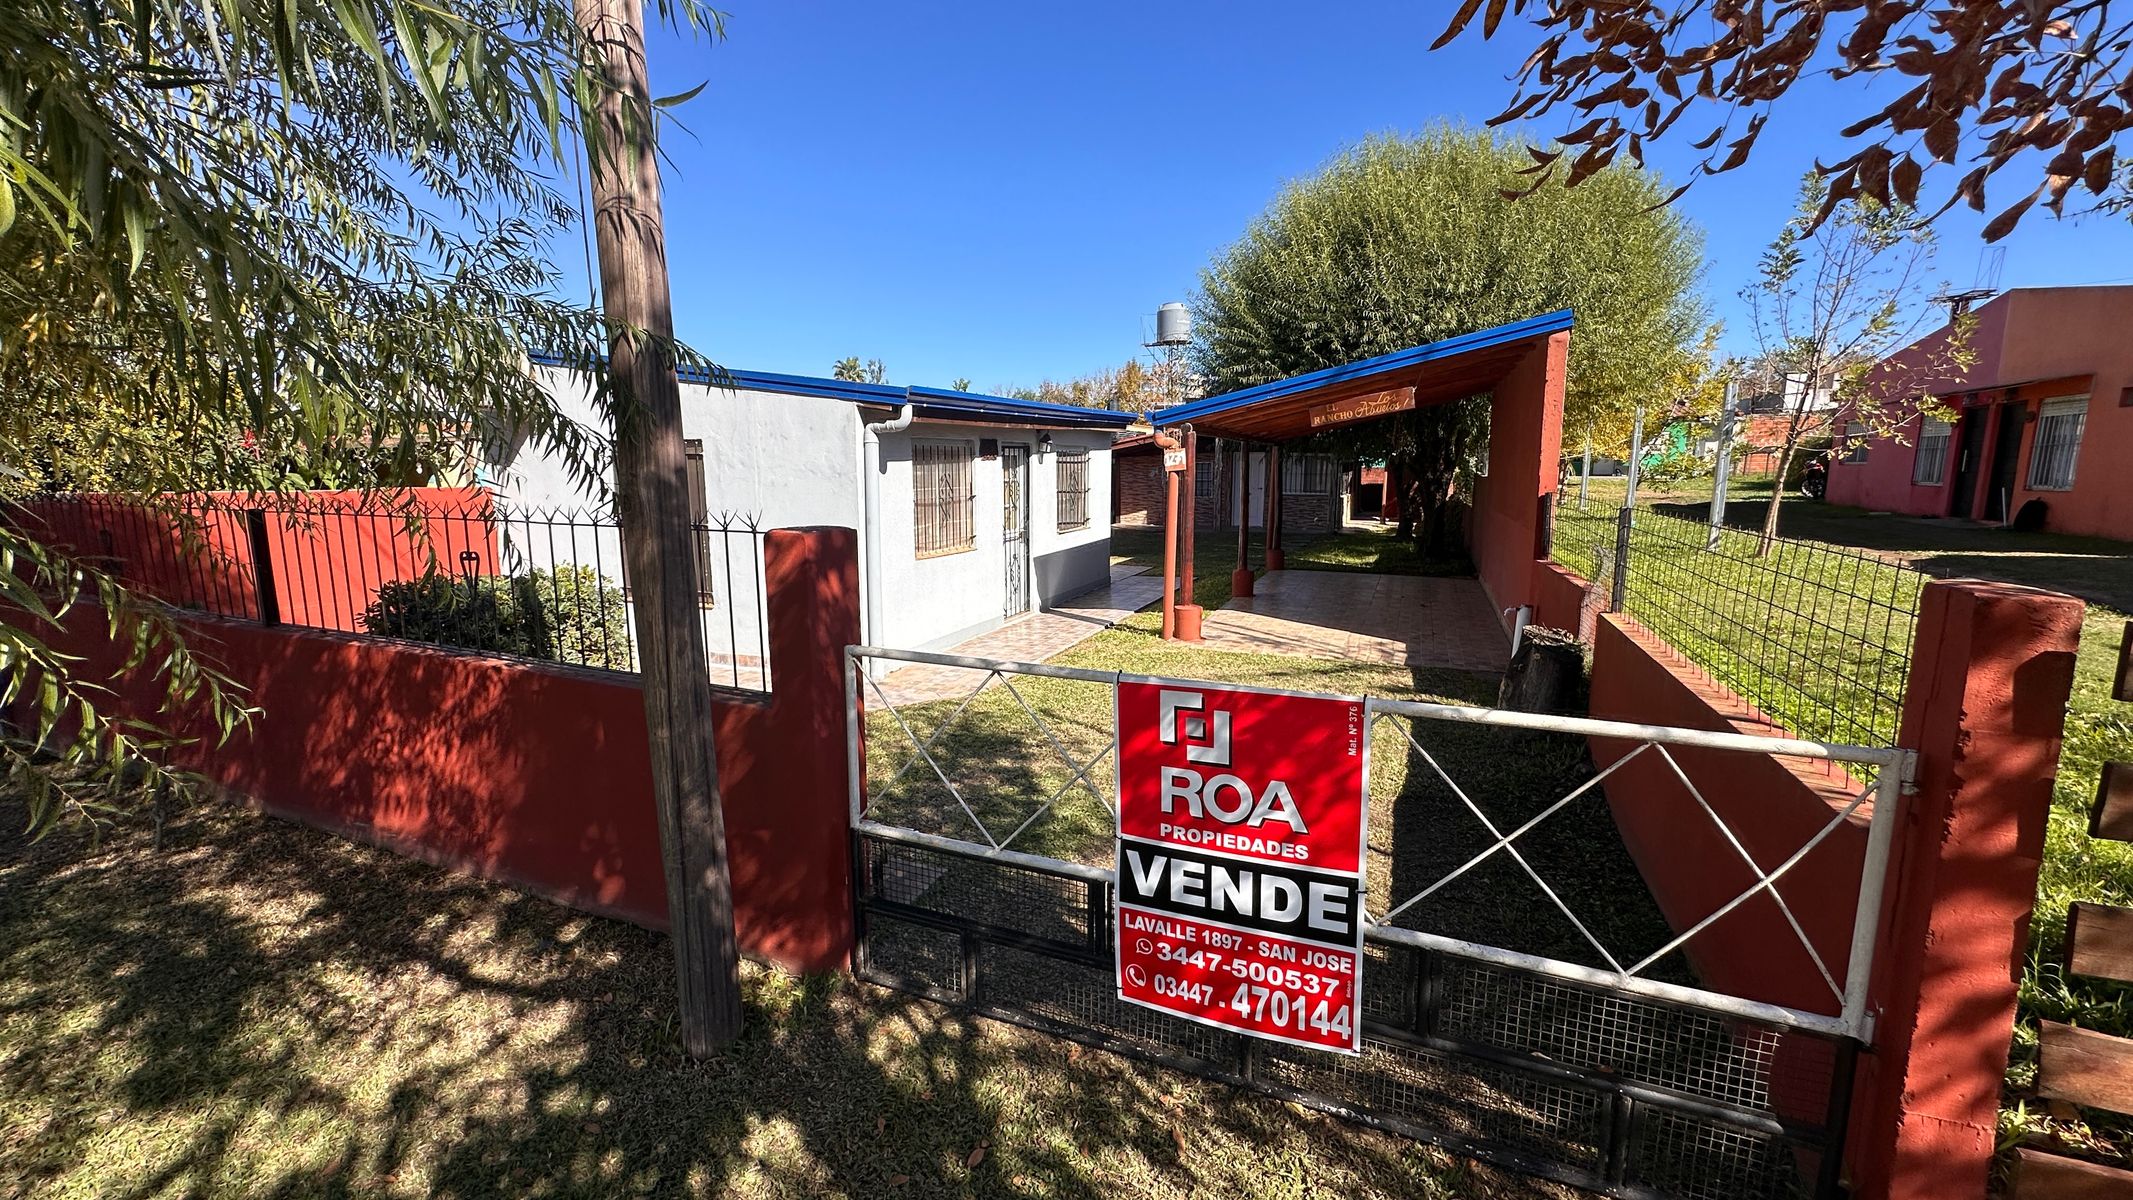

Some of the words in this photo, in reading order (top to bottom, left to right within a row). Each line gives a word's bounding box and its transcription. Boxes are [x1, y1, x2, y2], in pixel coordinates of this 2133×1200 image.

[1313, 410, 1353, 425] RANCHO
[1326, 404, 1338, 412] EL
[1349, 706, 1358, 722] 376
[1160, 765, 1308, 834] ROA
[1160, 823, 1309, 860] PROPIEDADES
[1125, 849, 1349, 934] VENDE
[1125, 913, 1196, 942] LAVALLE
[1202, 930, 1243, 951] 1897
[1258, 941, 1296, 963] SAN
[1301, 951, 1352, 974] JOSE
[1156, 942, 1340, 998] 3447-500537
[1154, 973, 1213, 1006] 03447
[1231, 983, 1352, 1041] 470144
